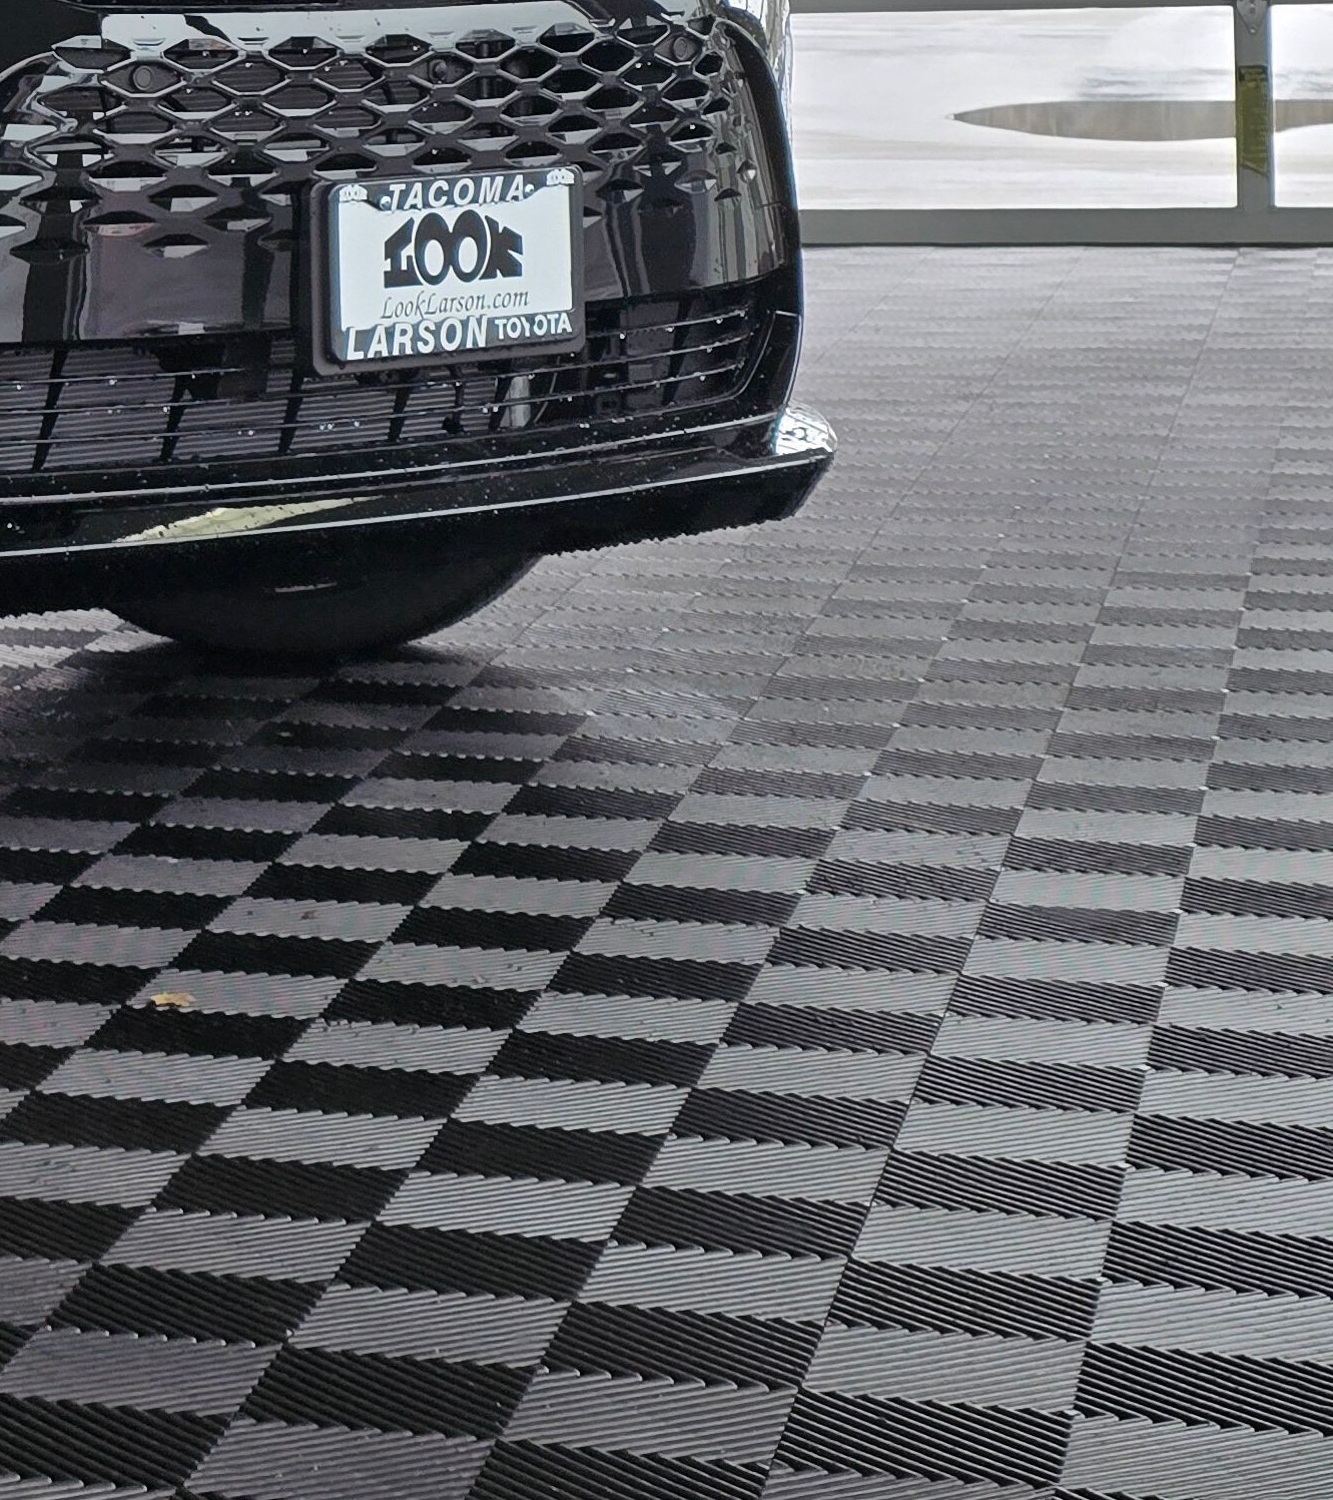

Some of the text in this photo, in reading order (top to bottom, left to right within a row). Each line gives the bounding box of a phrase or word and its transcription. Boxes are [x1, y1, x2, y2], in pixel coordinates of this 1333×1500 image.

[389, 174, 524, 211] TACOMA
[381, 290, 529, 320] LookLarson.com
[346, 312, 573, 361] LARSON TOYOTA
